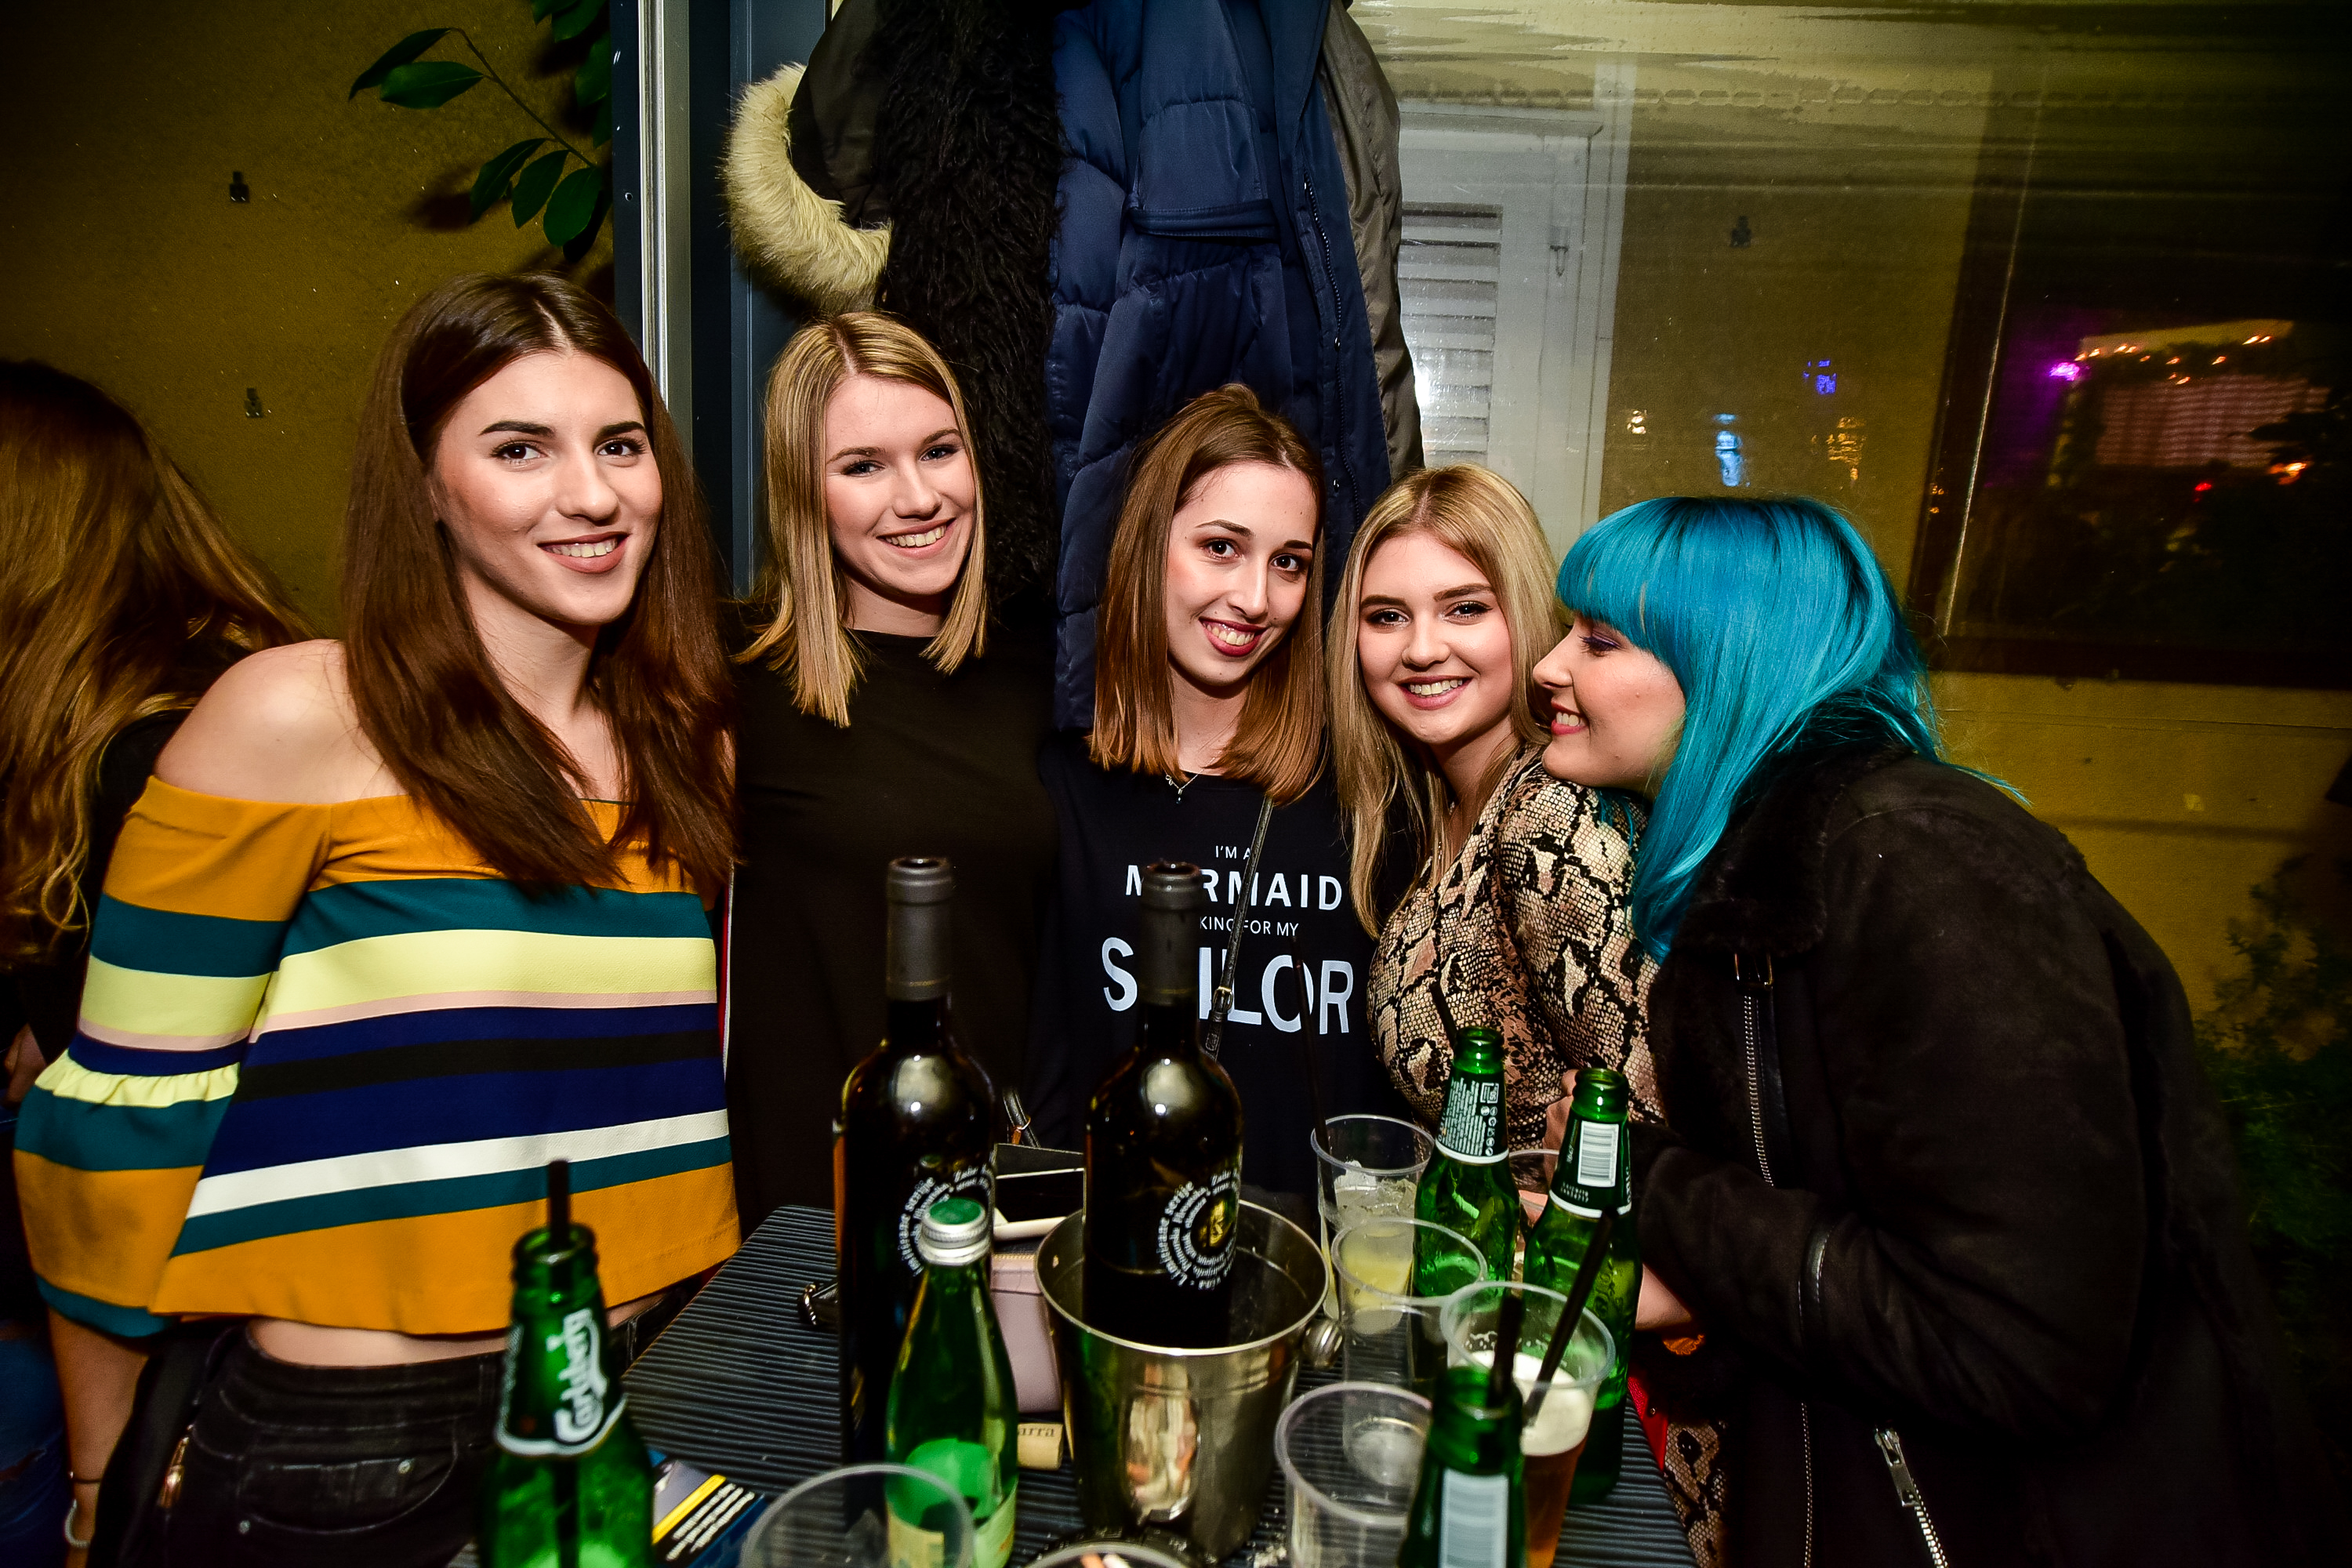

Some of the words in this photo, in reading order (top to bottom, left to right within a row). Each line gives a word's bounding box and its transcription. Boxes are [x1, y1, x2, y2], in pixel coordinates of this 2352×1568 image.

[1215, 845, 1237, 859] I'M
[1243, 847, 1251, 860] A
[1125, 864, 1342, 911] MRMAID
[1200, 916, 1235, 932] KING
[1276, 921, 1299, 937] MY
[1102, 936, 1354, 1035] SILOR
[1164, 1180, 1194, 1216] serije
